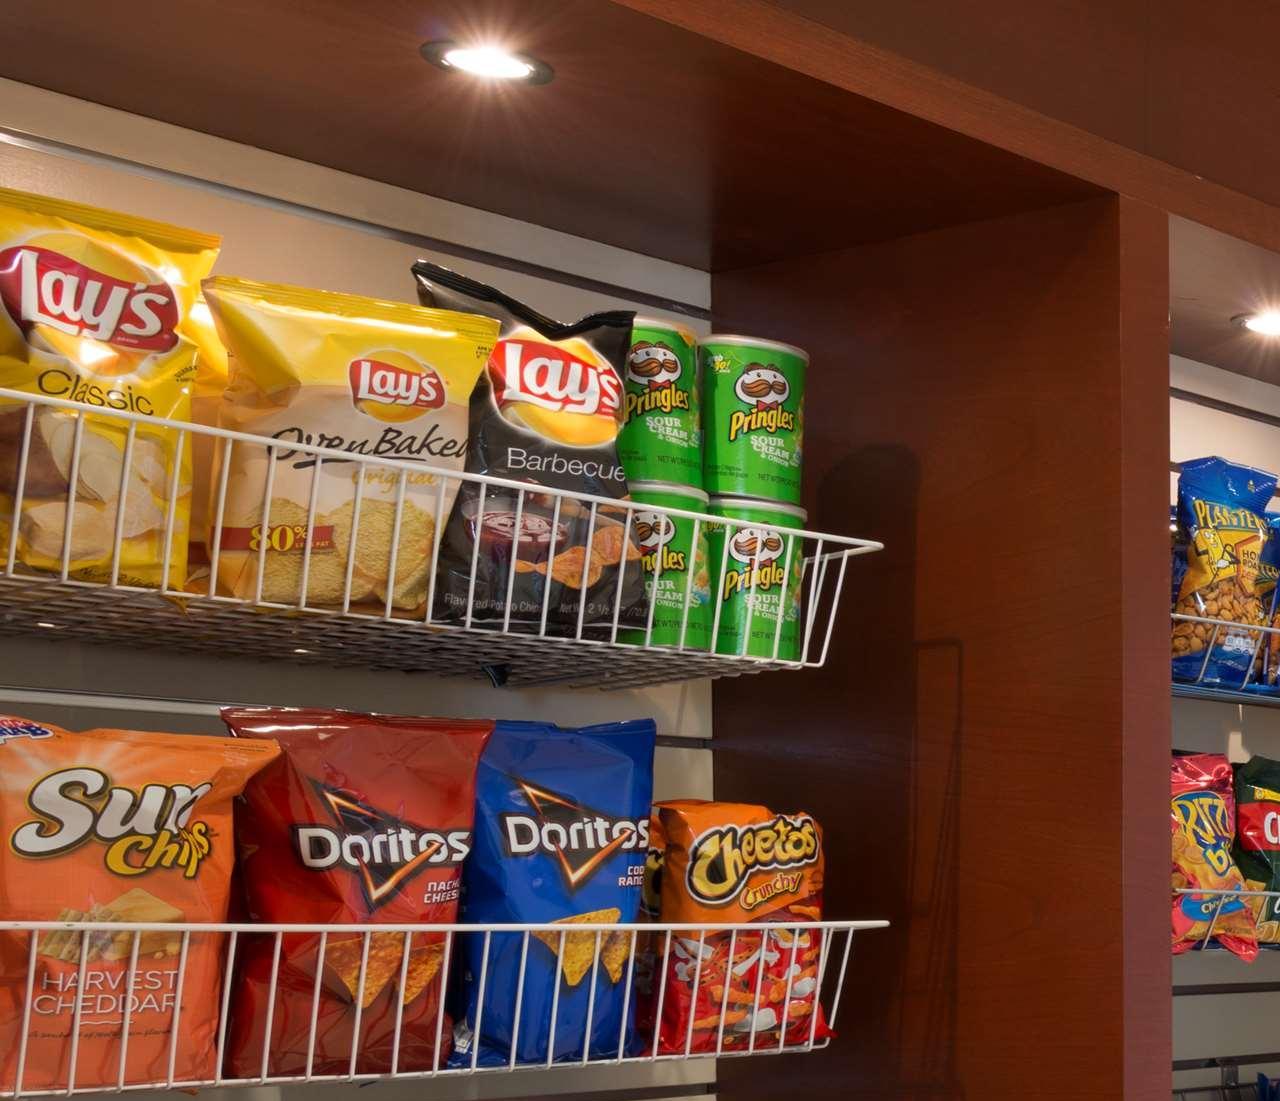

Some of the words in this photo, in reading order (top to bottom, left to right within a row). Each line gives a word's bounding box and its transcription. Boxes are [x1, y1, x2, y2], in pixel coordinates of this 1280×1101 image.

[20, 249, 170, 340] Lay's
[38, 369, 154, 417] Classic
[357, 358, 438, 405] Lay's
[503, 342, 622, 414] Lay's
[624, 382, 689, 425] Pringles
[646, 416, 682, 428] SOUR
[728, 404, 794, 442] Pringles
[267, 426, 371, 469] Oven
[650, 426, 688, 440] CREAM
[751, 435, 785, 447] SOUR
[753, 443, 790, 460] CREAM
[506, 446, 625, 482] Barbecue
[13, 768, 213, 860] Sun
[506, 816, 650, 855] Doritos
[1171, 797, 1231, 848] RITZ
[105, 822, 210, 879] Chips
[298, 825, 471, 869] Doritos
[690, 815, 819, 903] Cheetos
[741, 870, 802, 910] Crunchy
[42, 969, 179, 993] HARVEST
[33, 991, 179, 1016] CHEDDAR
